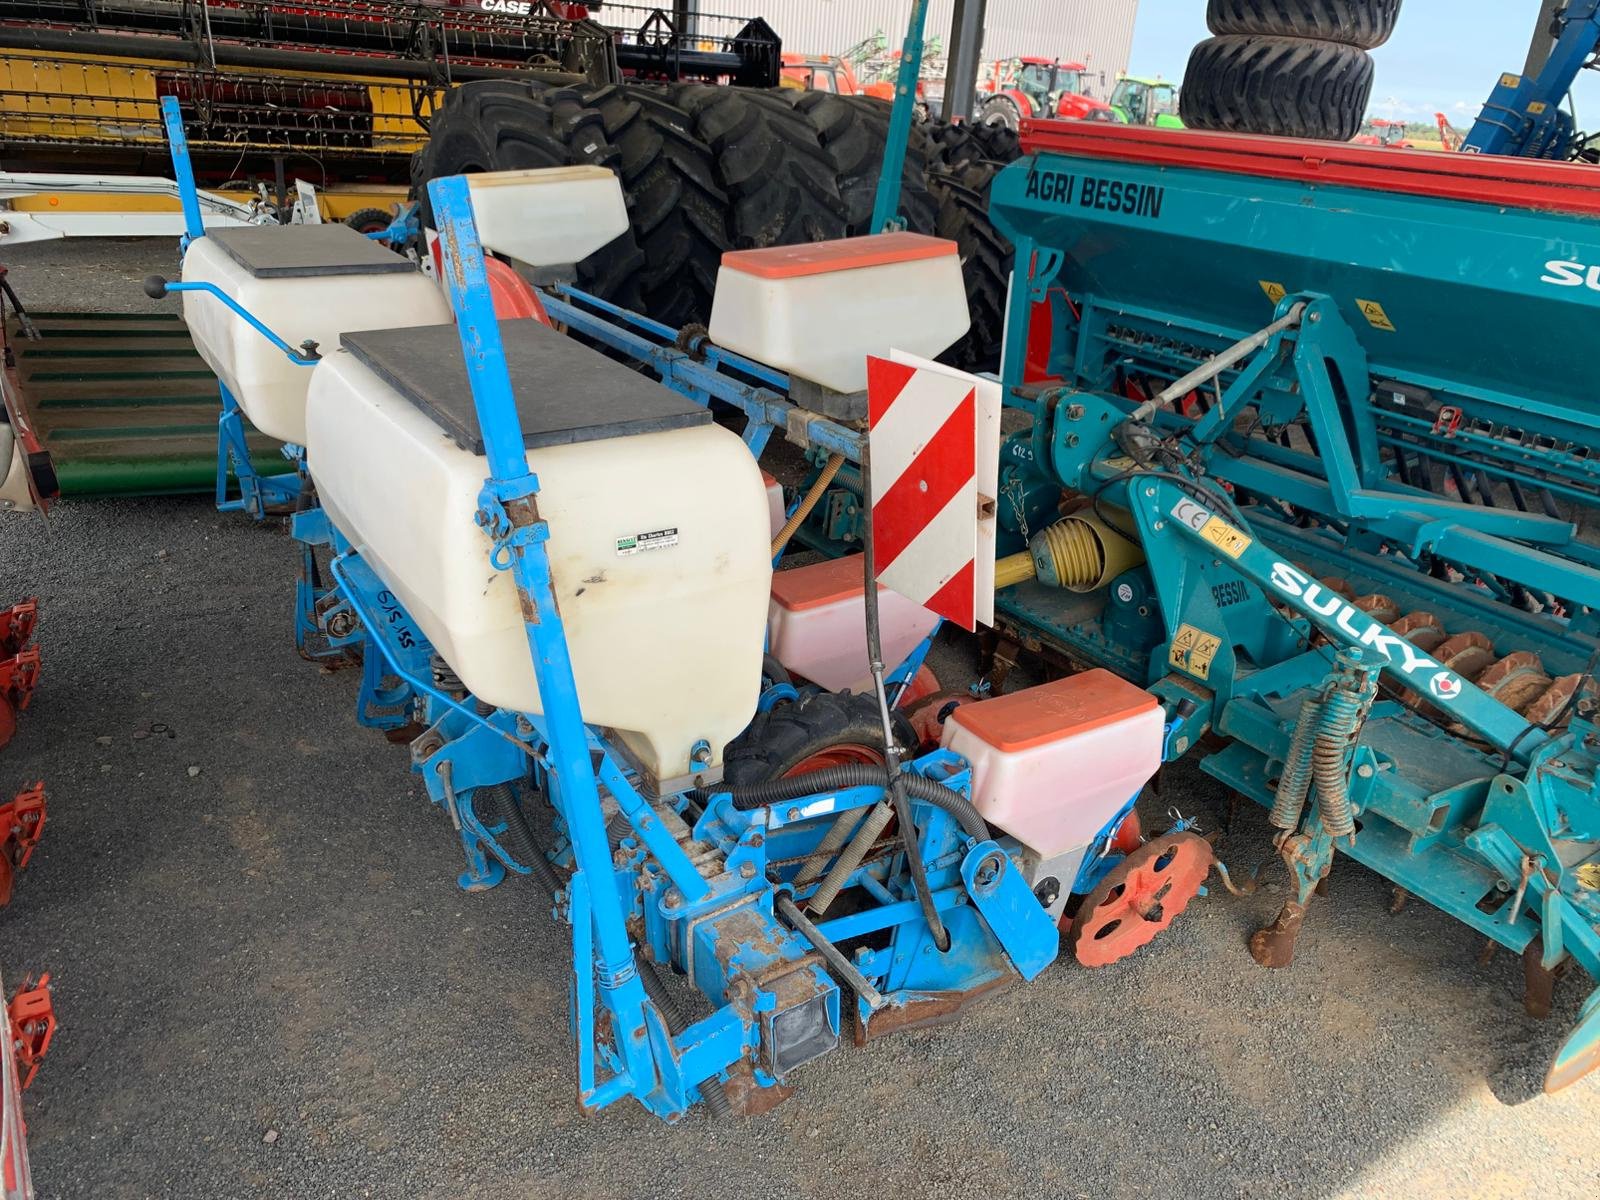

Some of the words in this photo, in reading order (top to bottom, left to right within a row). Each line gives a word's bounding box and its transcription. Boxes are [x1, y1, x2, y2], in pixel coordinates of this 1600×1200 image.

[480, 0, 531, 15] CASE
[1025, 169, 1075, 205] AGRI
[1080, 176, 1165, 219] BESSIN
[1177, 502, 1208, 529] CE
[1270, 562, 1440, 675] SULKY
